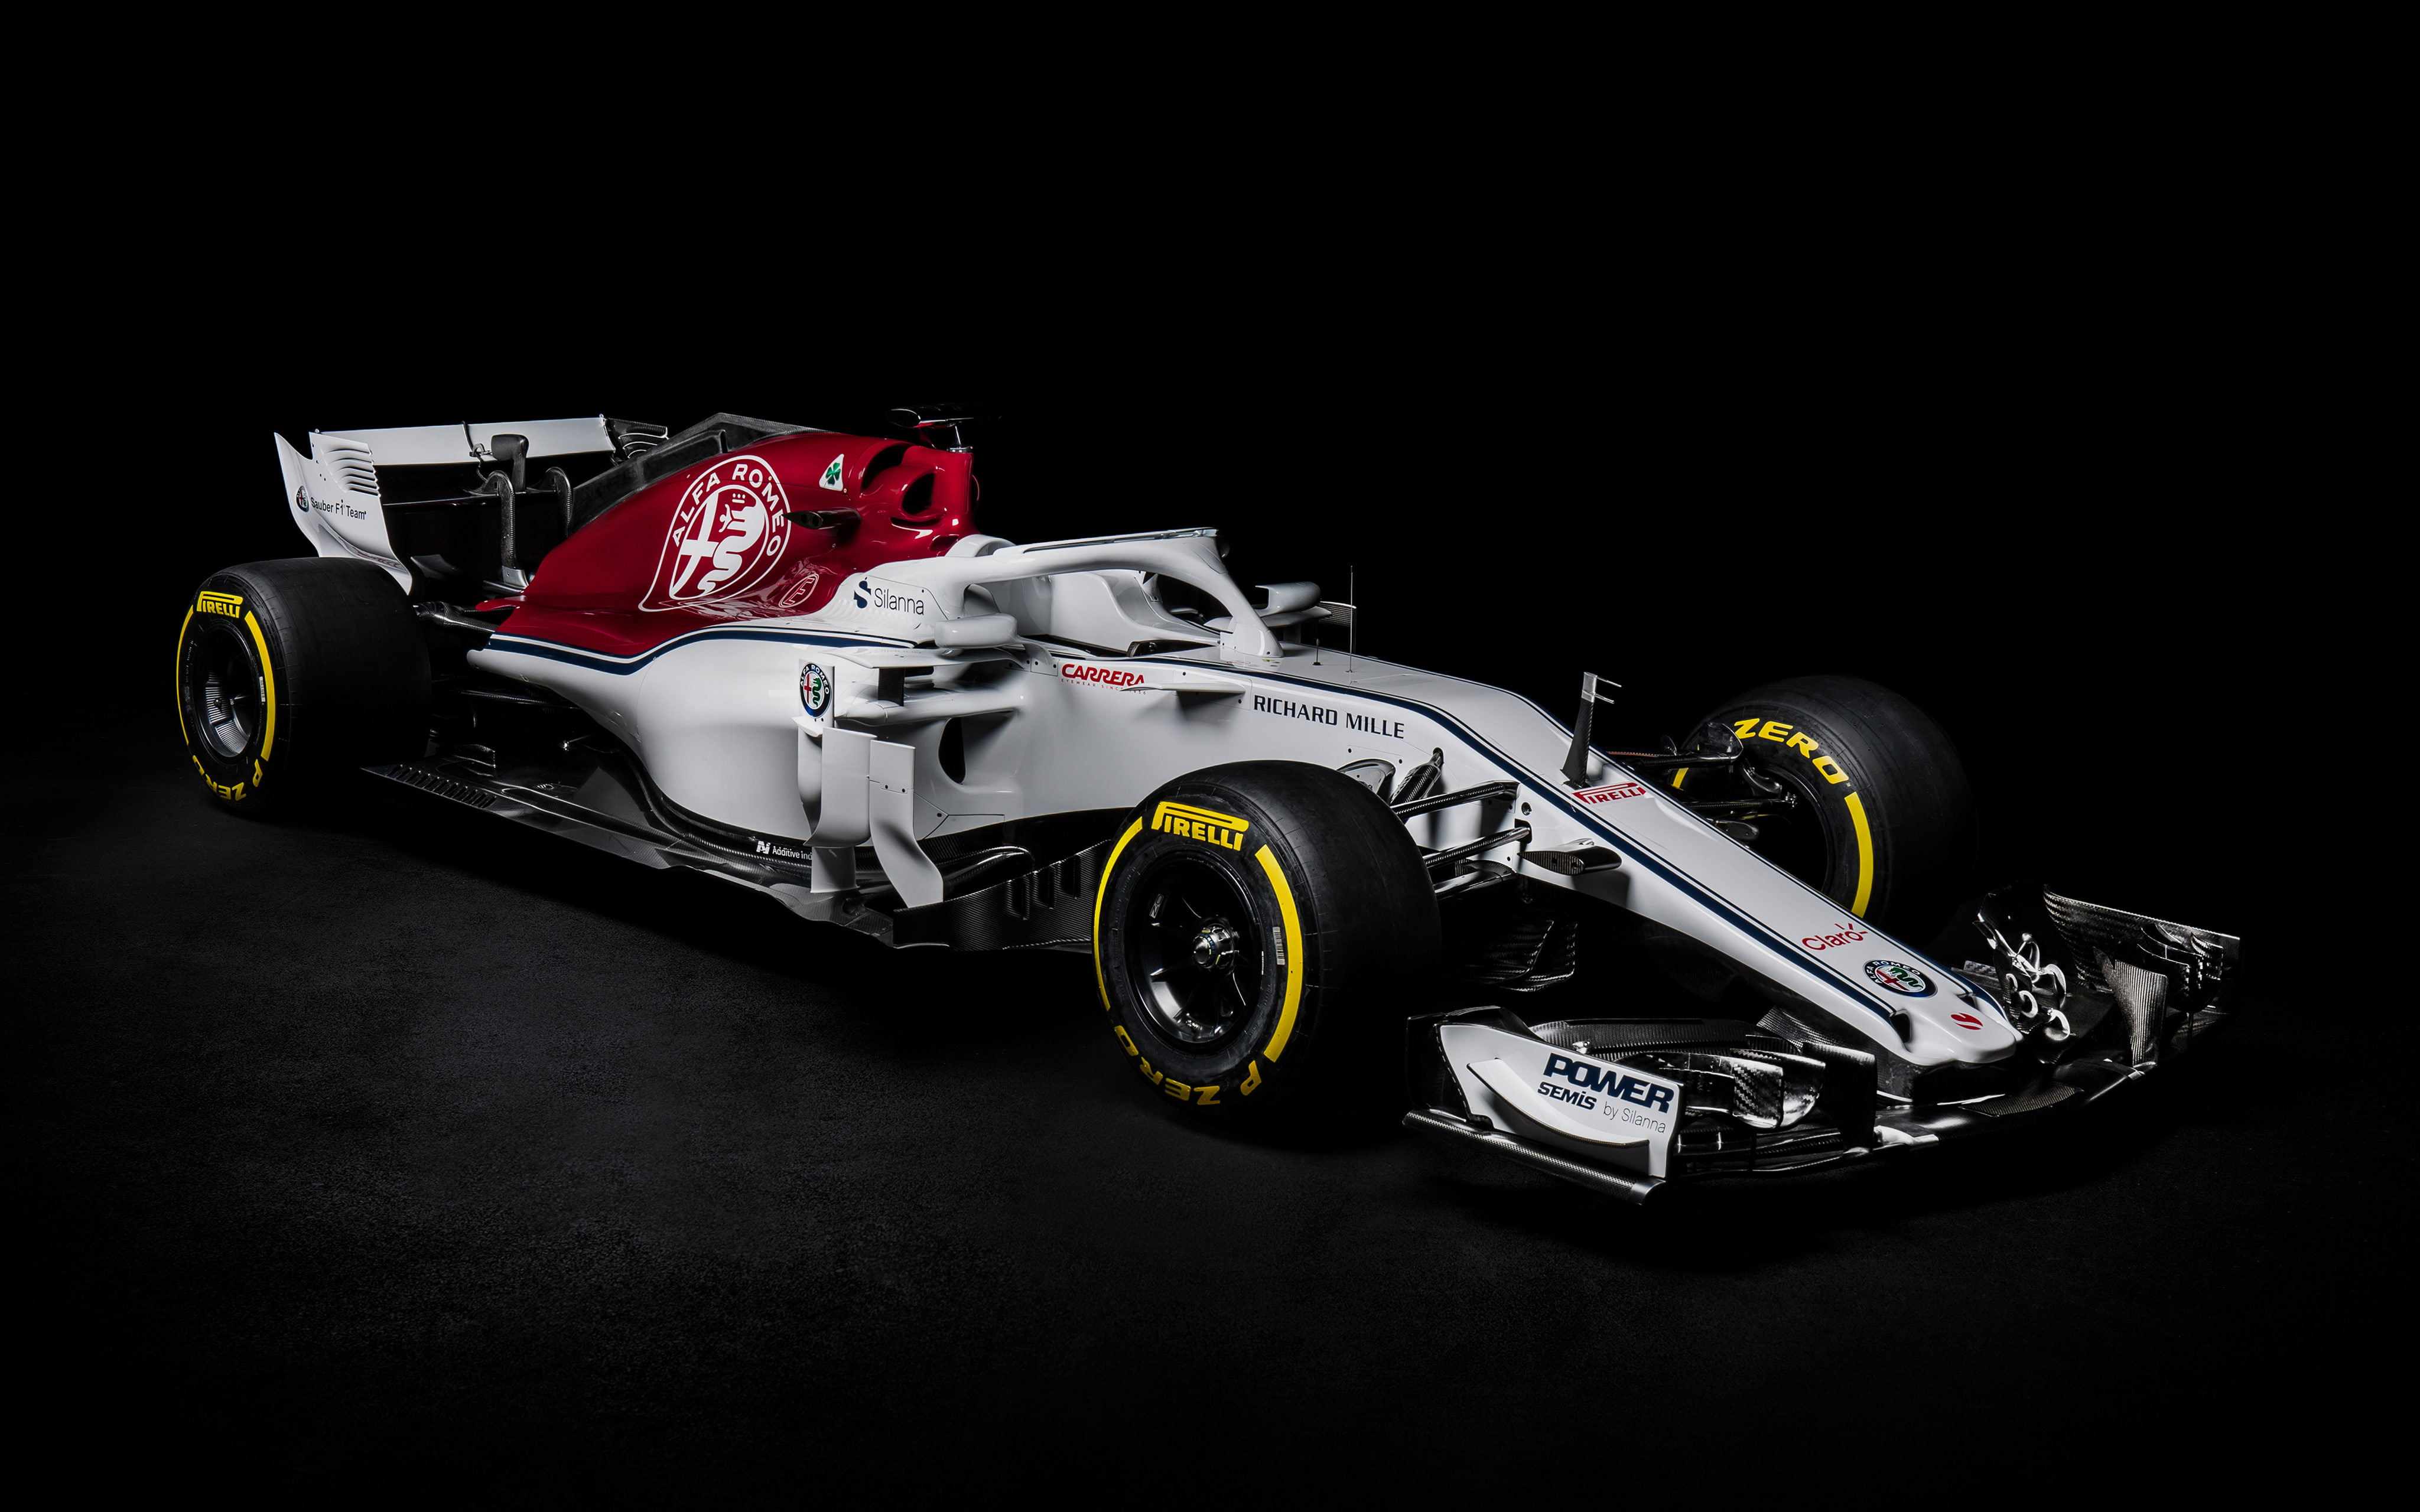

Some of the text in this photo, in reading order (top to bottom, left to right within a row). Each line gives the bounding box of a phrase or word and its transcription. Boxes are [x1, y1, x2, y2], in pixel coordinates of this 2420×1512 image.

[310, 497, 334, 513] Sauber
[346, 505, 366, 520] Team
[672, 464, 784, 556] ALFA ROMEO
[196, 591, 243, 618] PIRELLI
[874, 588, 924, 615] Silanna
[800, 664, 830, 694] ALFA ROMEO
[1061, 678, 1096, 687] EYEWEAR
[1062, 664, 1144, 686] CARRERA
[1254, 695, 1404, 739] RICHARD MILLE
[1732, 718, 1849, 784] ZERO
[252, 758, 263, 787] P
[1572, 782, 1647, 804] PIRELLI
[1151, 801, 1249, 851] PIRELLI
[772, 846, 800, 858] Additive
[1802, 923, 1868, 950] Claro
[1867, 960, 1920, 983] ALFA ROMEO
[1114, 1025, 1262, 1106] P ZERO
[1543, 1052, 1674, 1113] POWER
[1603, 1101, 1619, 1120] by
[1622, 1108, 1666, 1133] Silanna
